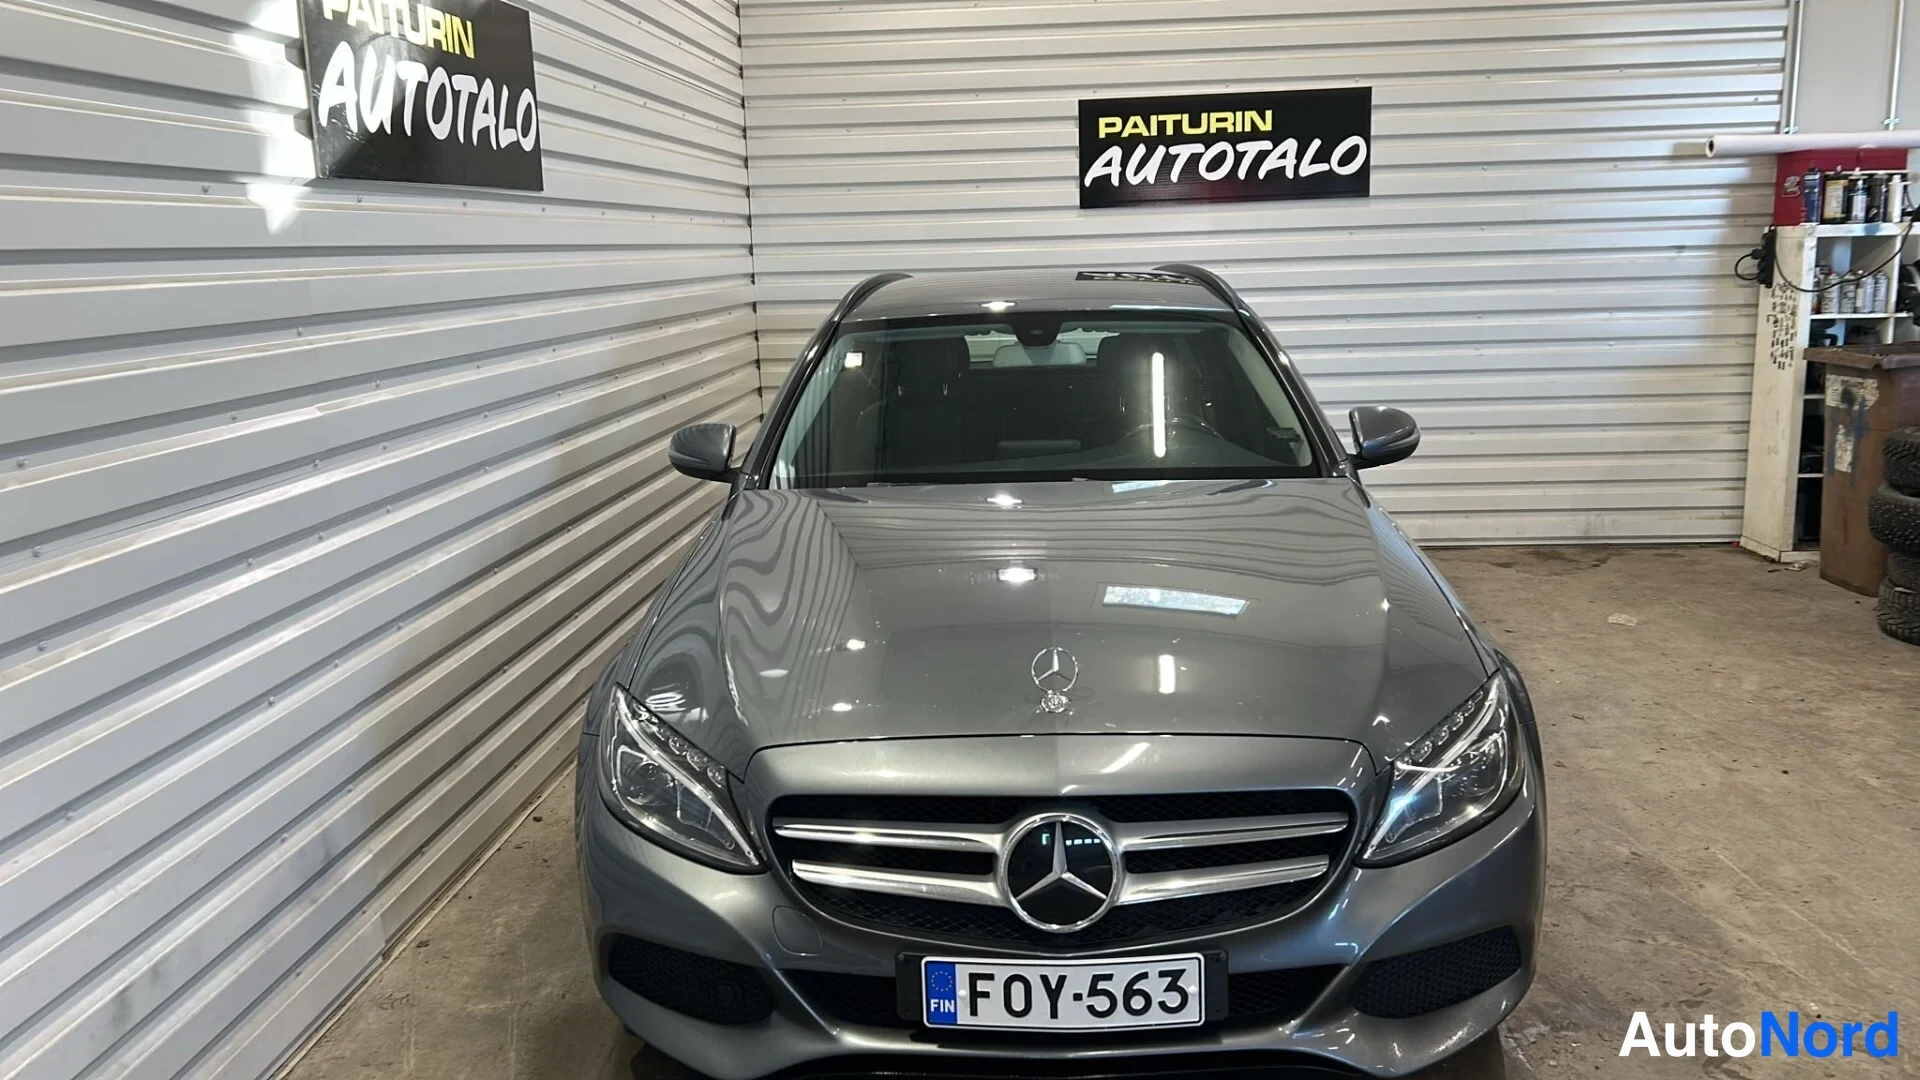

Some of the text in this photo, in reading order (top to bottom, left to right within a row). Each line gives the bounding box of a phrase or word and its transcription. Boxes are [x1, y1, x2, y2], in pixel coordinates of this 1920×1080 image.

[318, 40, 537, 152] AUTOTALO
[1098, 109, 1273, 139] PAITURIN
[1084, 135, 1367, 187] AUTOTALO
[930, 998, 955, 1013] FIN
[968, 968, 1190, 1020] FOY-563
